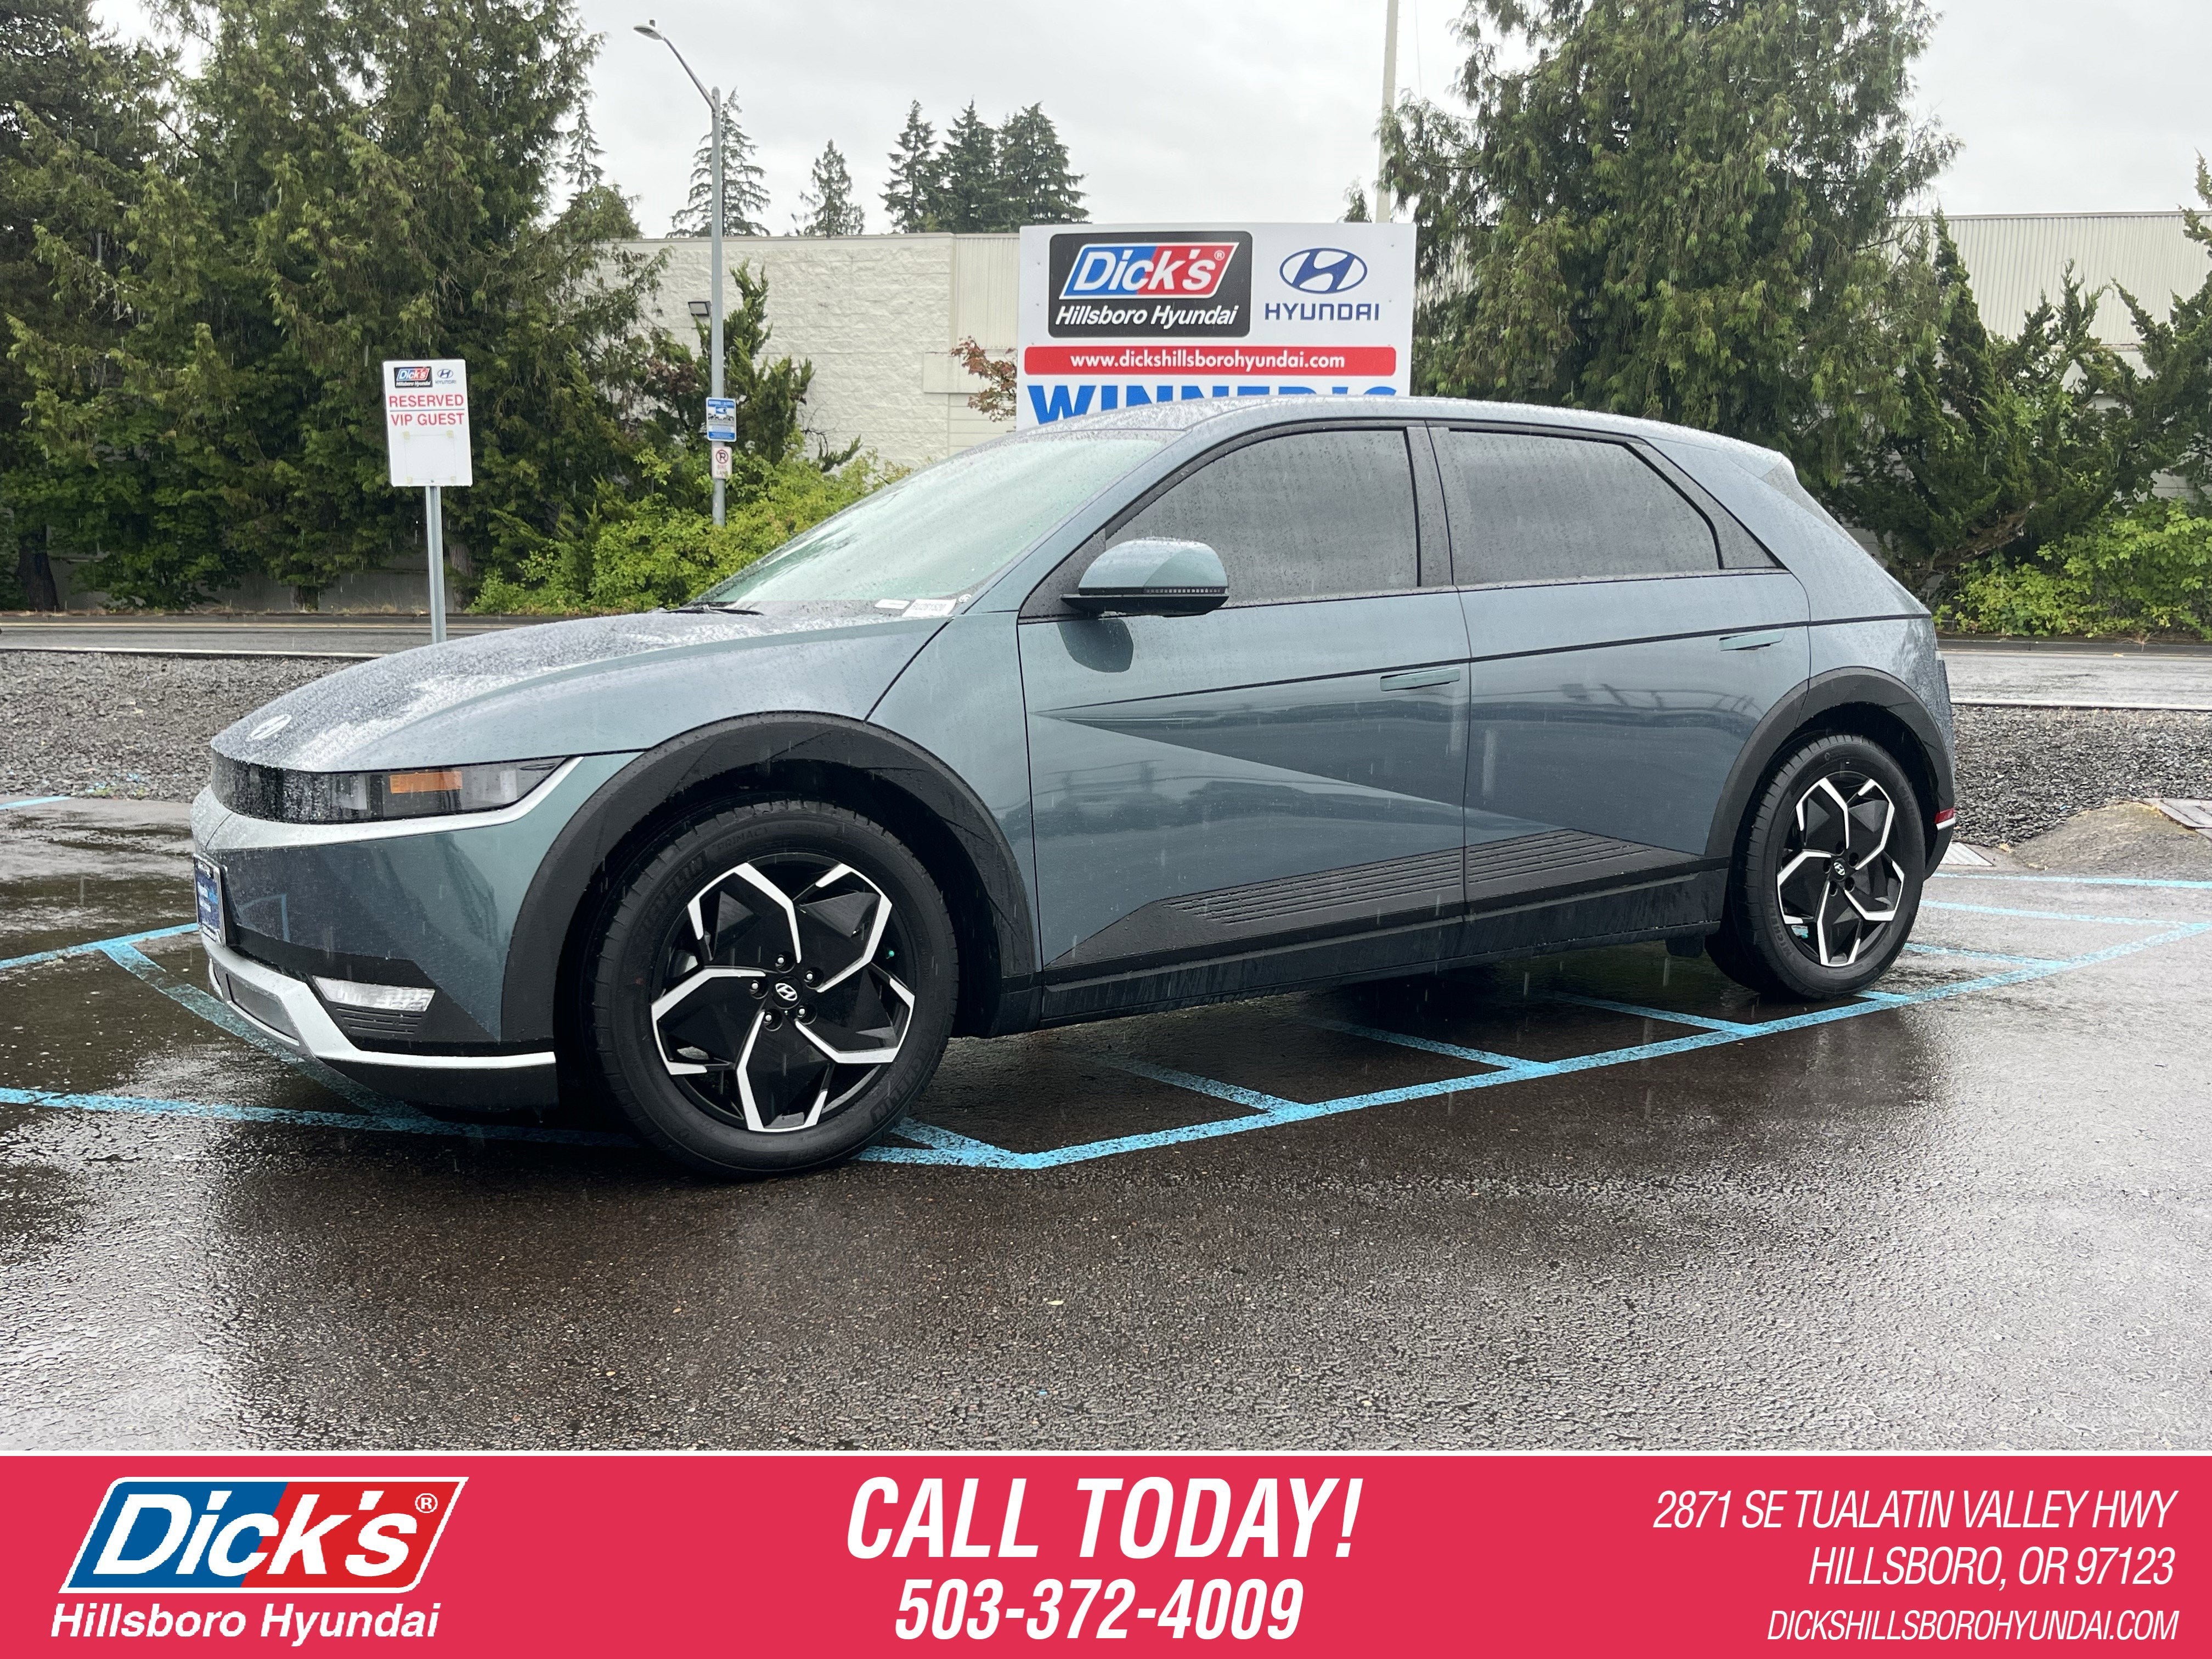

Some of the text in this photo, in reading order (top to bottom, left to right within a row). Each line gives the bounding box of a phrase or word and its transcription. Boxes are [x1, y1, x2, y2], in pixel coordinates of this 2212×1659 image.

[1056, 306, 1239, 329] Hillsboro Hyundai
[1266, 303, 1379, 321] HYUNDAI
[1070, 349, 1345, 372] www.dickshillsborohyundai.com
[389, 394, 464, 407] RESERVED
[391, 413, 464, 426] VIP GUEST
